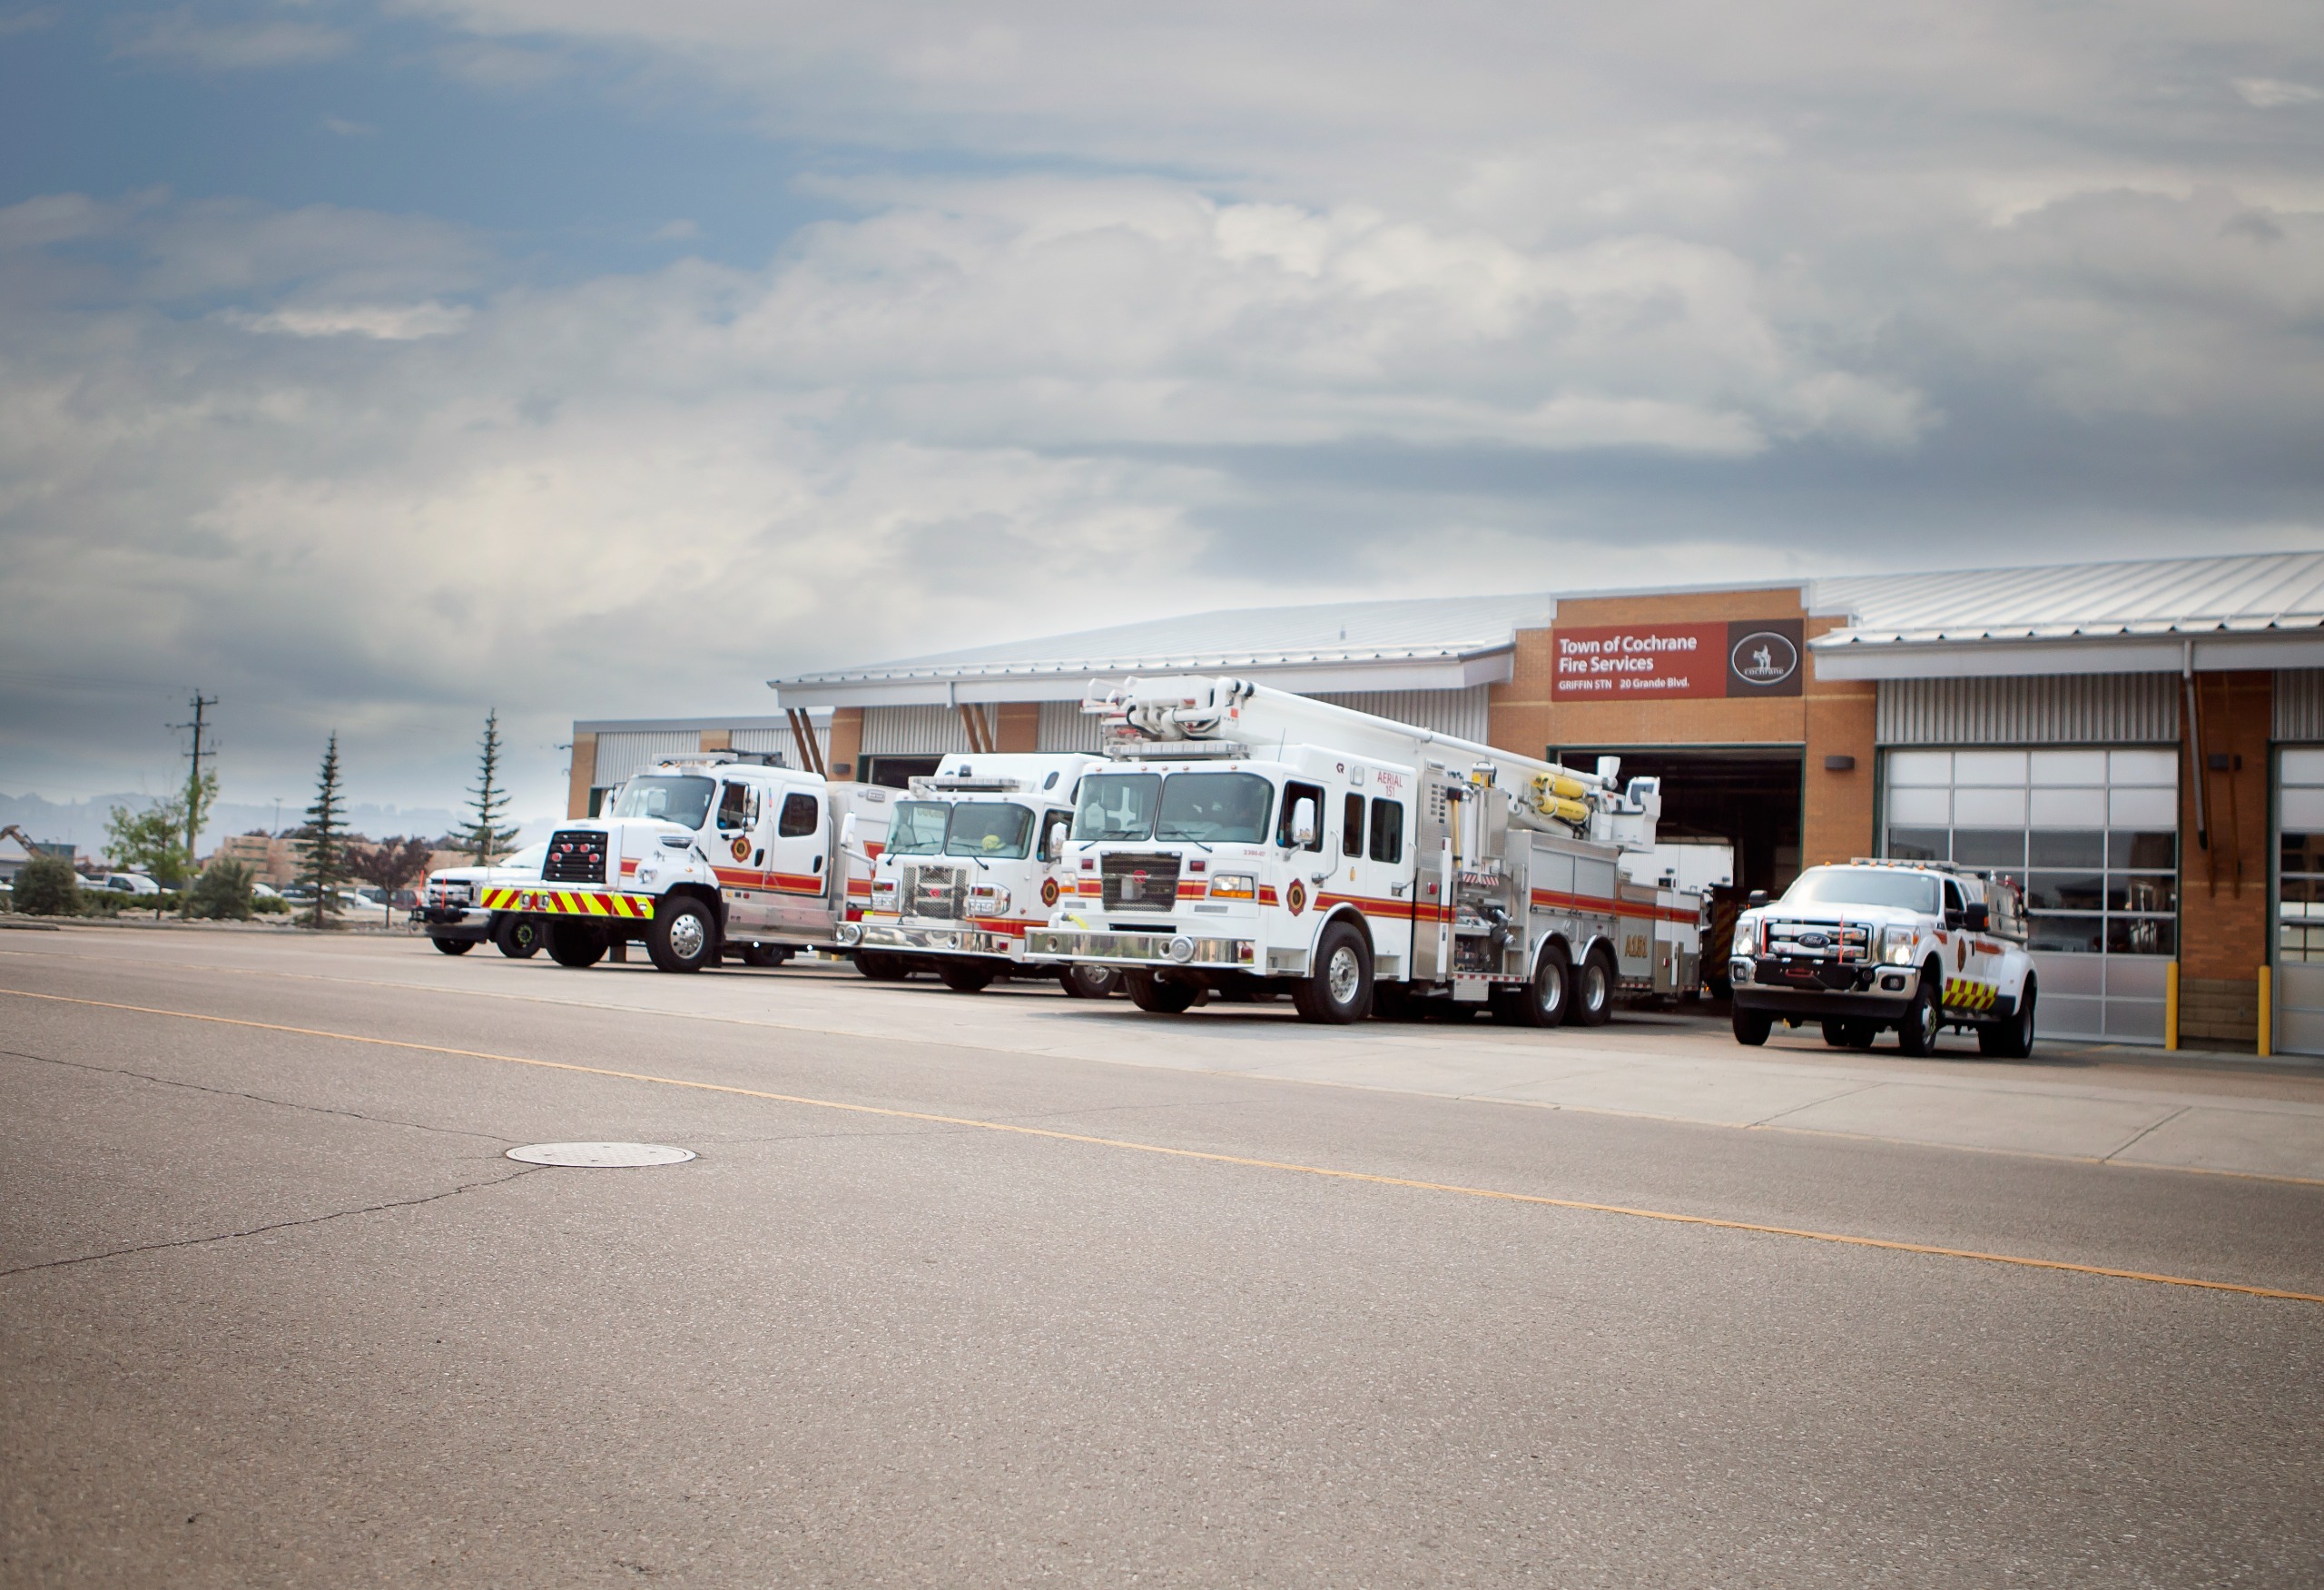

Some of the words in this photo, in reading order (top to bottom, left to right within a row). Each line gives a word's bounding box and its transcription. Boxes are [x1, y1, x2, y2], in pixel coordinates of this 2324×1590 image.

[1559, 638, 1600, 654] Town
[1603, 636, 1621, 653] of
[1621, 634, 1698, 653] Cochrane
[1559, 657, 1588, 673] Fire
[1590, 655, 1654, 673] Services
[1559, 679, 1593, 691] GRIFFIN
[1594, 678, 1612, 690] STN
[1620, 677, 1631, 689] 20
[1632, 676, 1666, 689] Grande
[1667, 676, 1690, 688] Blvd.
[1377, 770, 1403, 788] AERIAL
[1385, 785, 1396, 798] 151
[1625, 933, 1649, 959] A151
[1806, 935, 1823, 945] Ford
